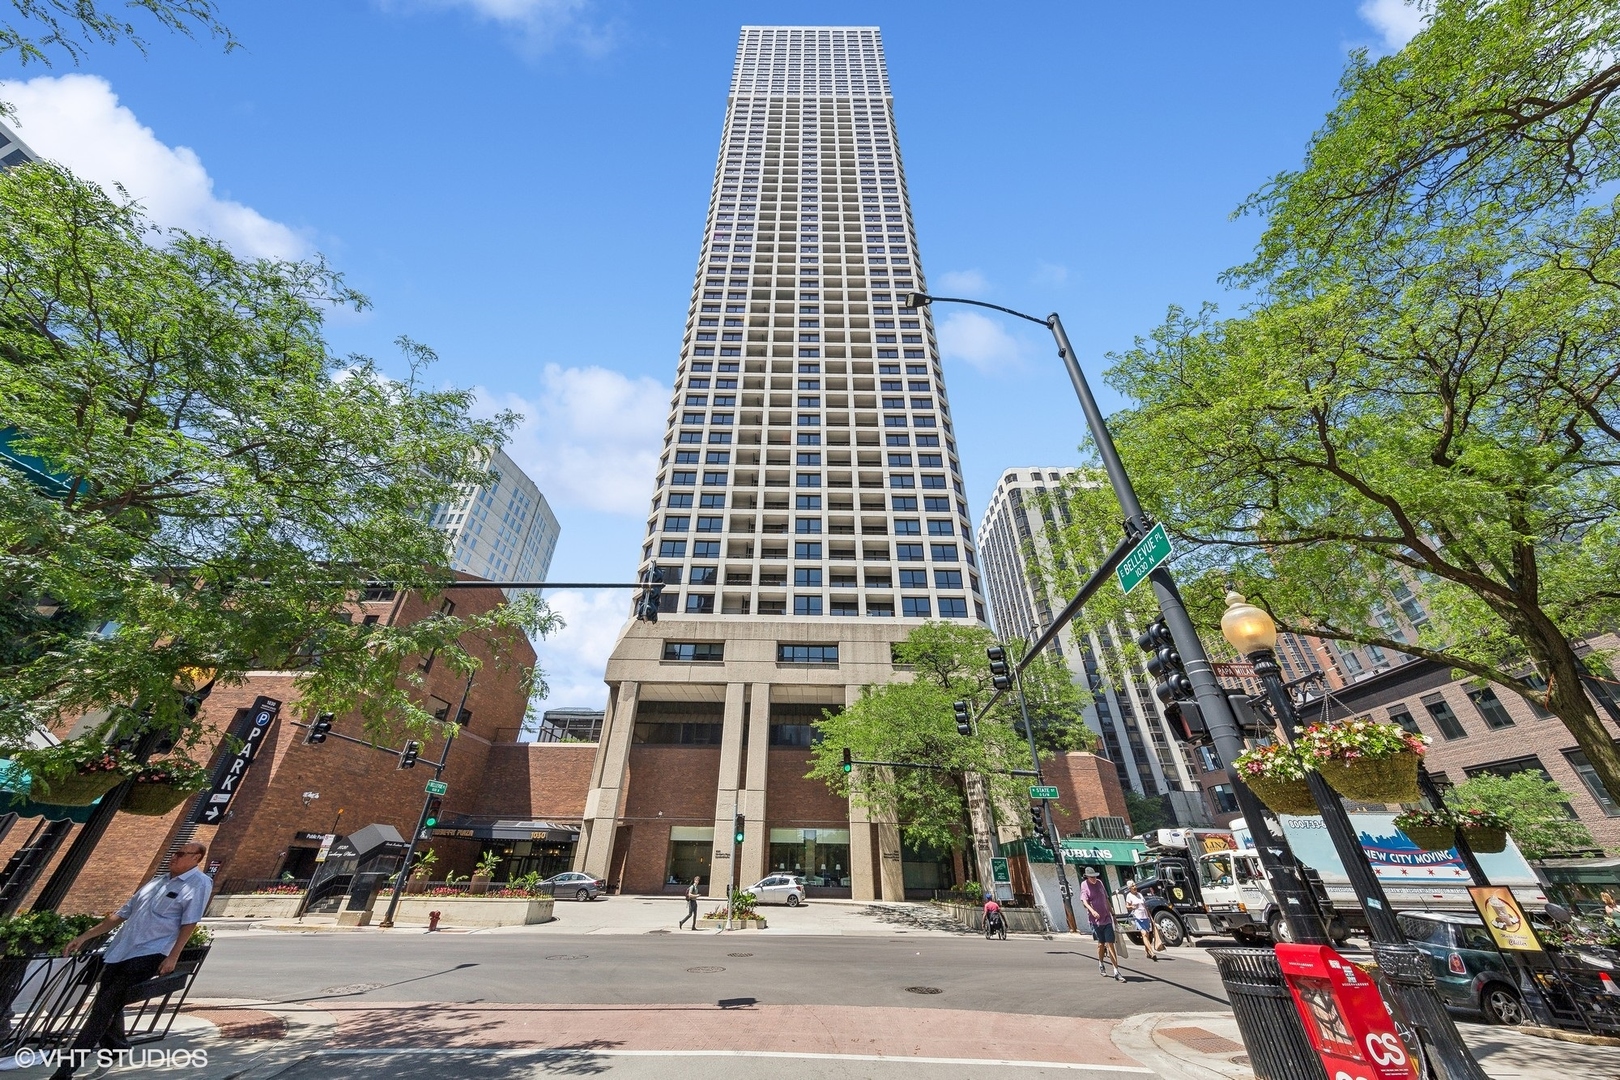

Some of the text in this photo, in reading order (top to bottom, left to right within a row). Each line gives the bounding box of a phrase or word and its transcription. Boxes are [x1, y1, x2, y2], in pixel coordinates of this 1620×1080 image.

[1120, 532, 1163, 578] E BELLEVUE PL
[1135, 555, 1155, 578] 1030 N
[221, 727, 261, 790] PARK
[1288, 820, 1327, 829] 800-733-6
[1205, 841, 1228, 849] LINZ
[1364, 849, 1453, 864] NEW CITY MOVING
[1366, 1032, 1406, 1066] CS
